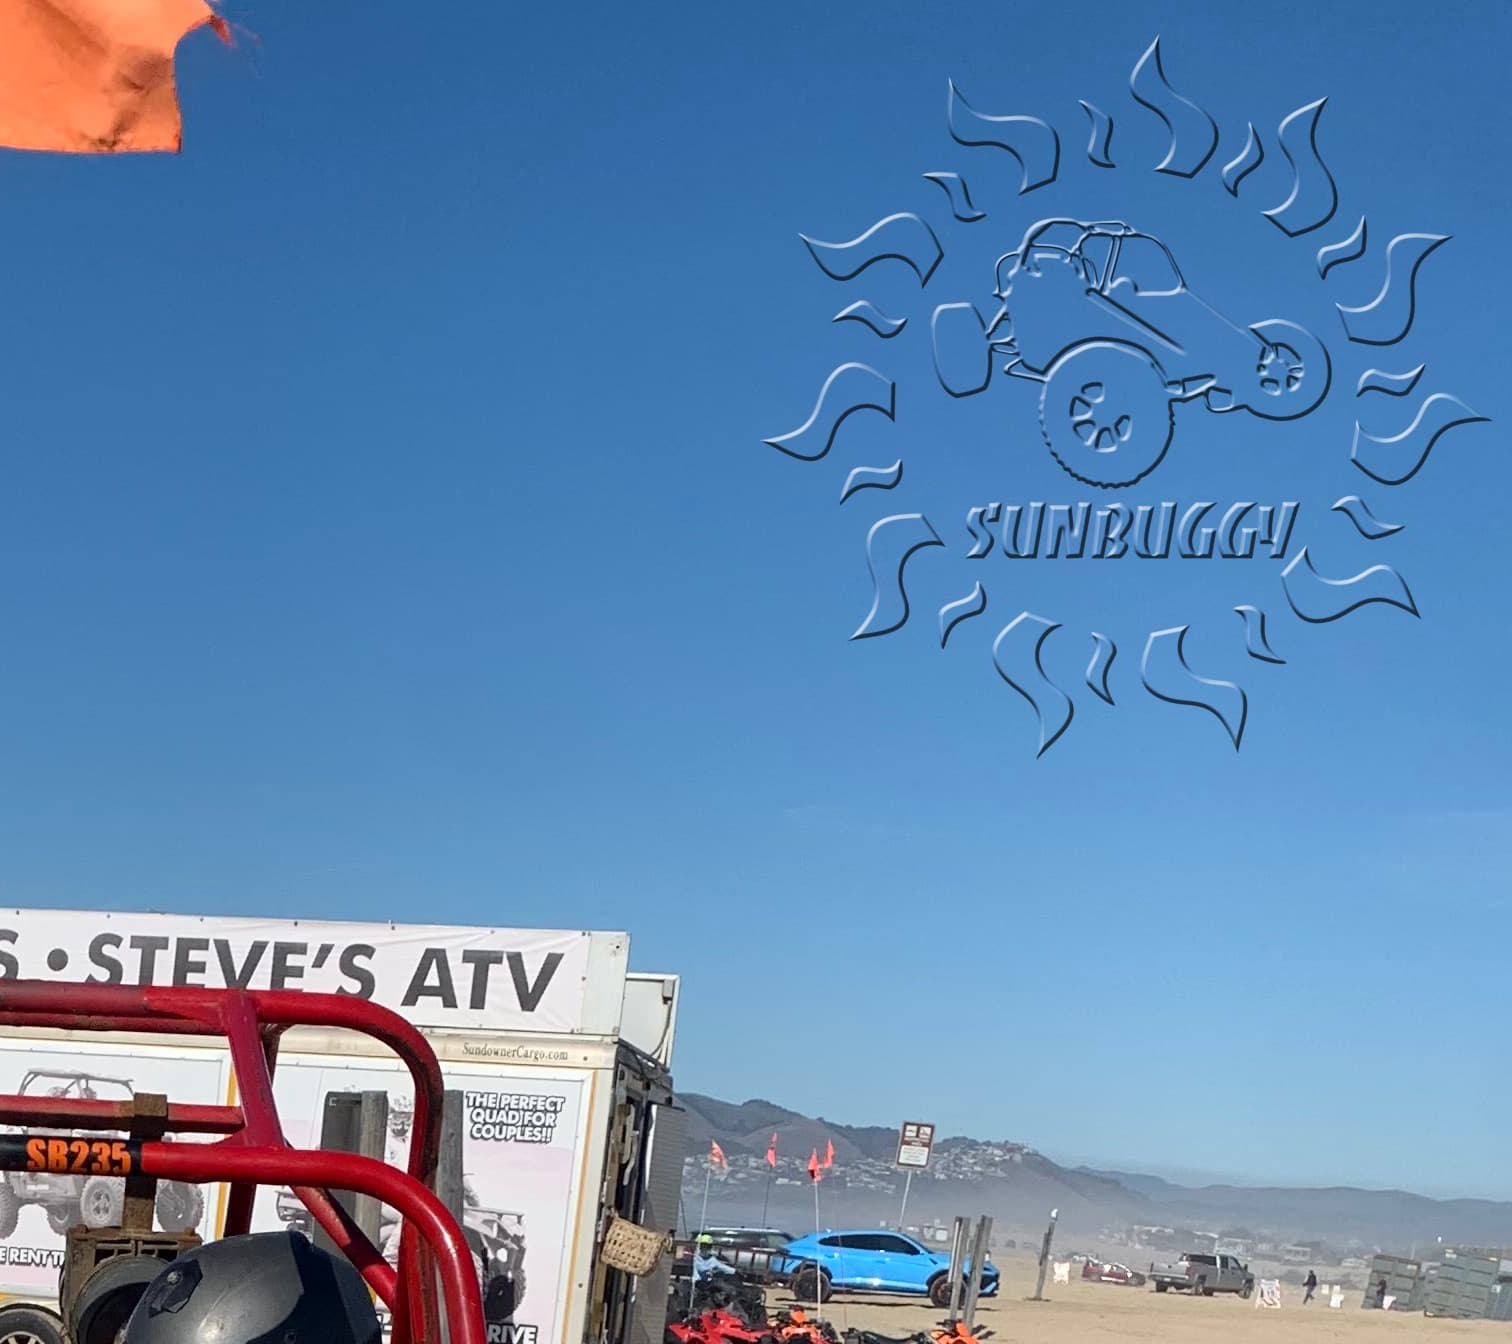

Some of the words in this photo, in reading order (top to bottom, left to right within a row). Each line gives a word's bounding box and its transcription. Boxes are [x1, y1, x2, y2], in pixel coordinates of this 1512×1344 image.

[87, 932, 377, 998] STEVE'S
[400, 947, 565, 1013] ATV
[462, 1042, 568, 1062] SundownerCargo.com
[466, 1091, 498, 1109] THE
[500, 1093, 565, 1112] PERFECT
[471, 1107, 521, 1126] QUAD
[523, 1111, 557, 1128] FOR
[470, 1124, 553, 1144] COUPLES!!
[26, 1138, 132, 1176] SB235
[8, 1248, 51, 1268] RENT
